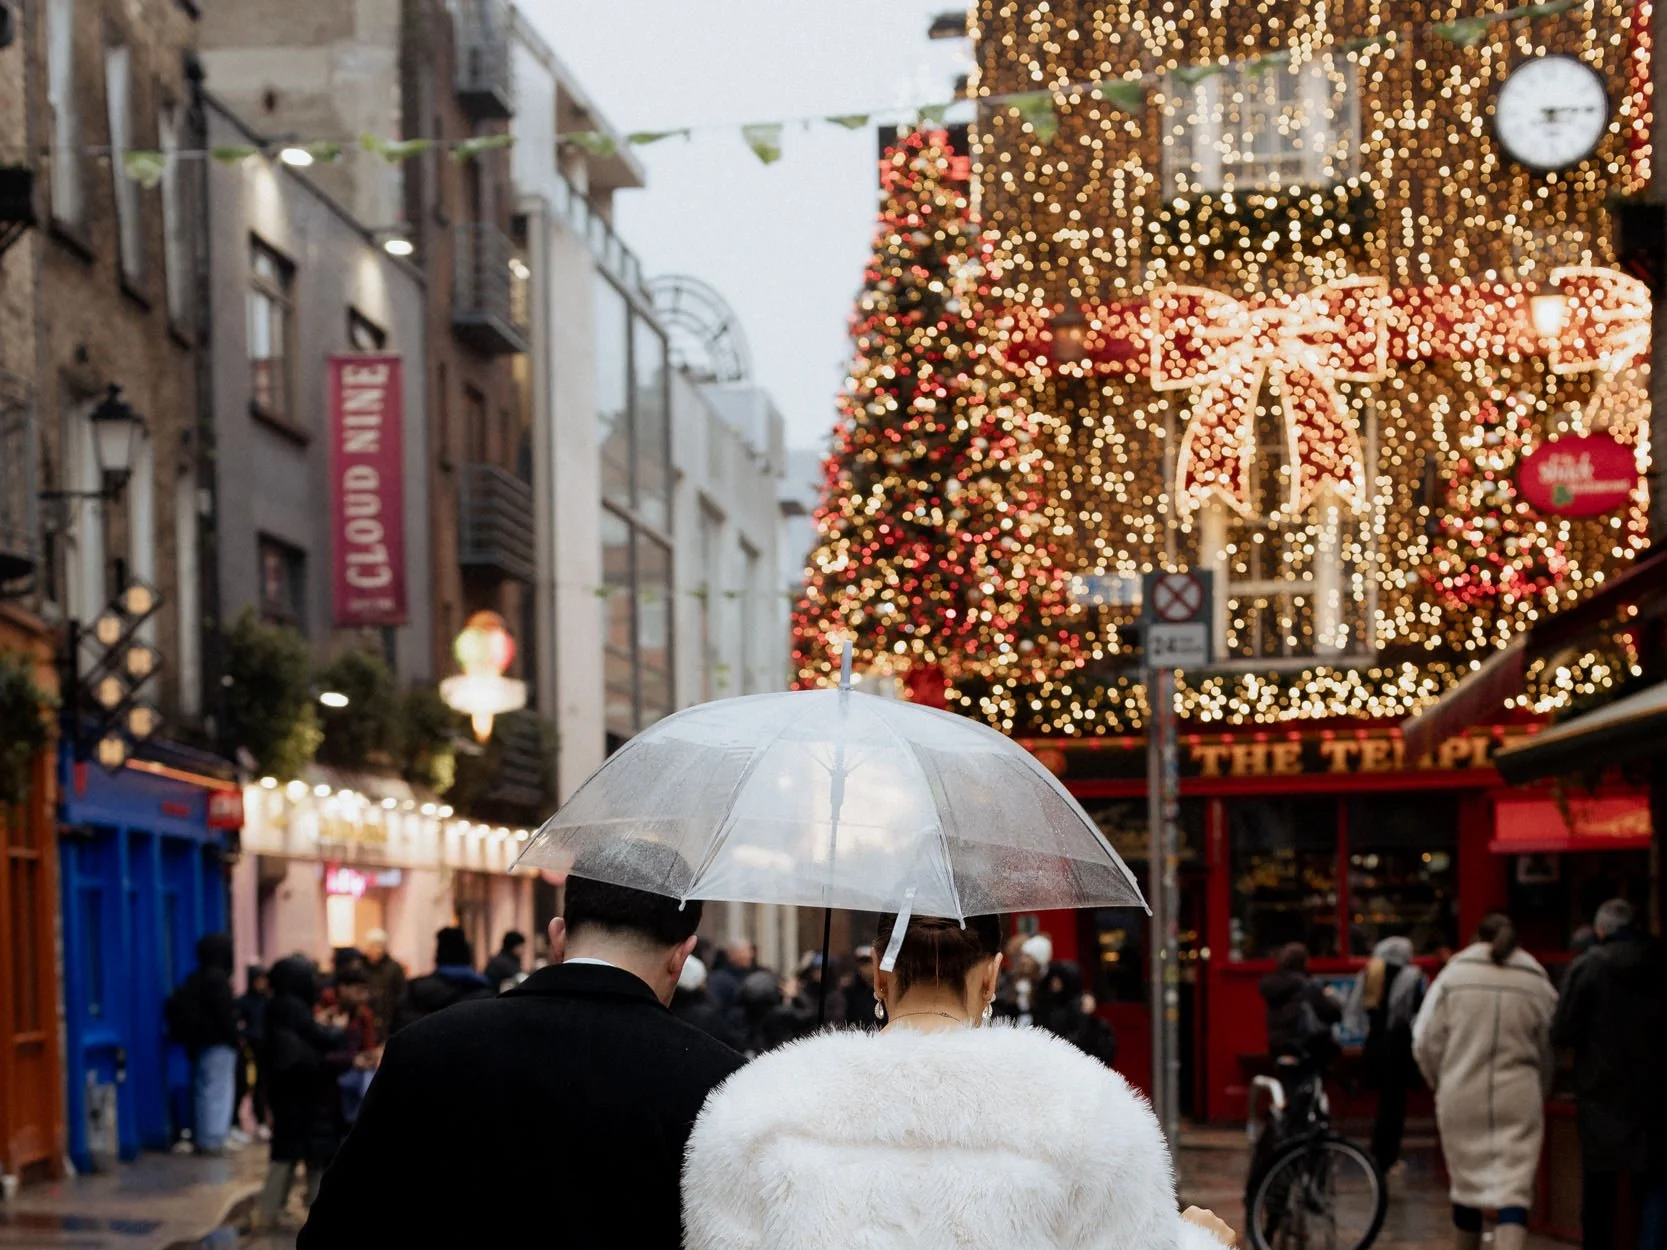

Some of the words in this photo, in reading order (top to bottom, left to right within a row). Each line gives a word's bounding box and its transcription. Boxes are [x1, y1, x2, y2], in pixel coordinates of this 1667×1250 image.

[341, 363, 390, 454] NINE
[344, 464, 392, 589] CLOUD
[1191, 742, 1303, 777] THE
